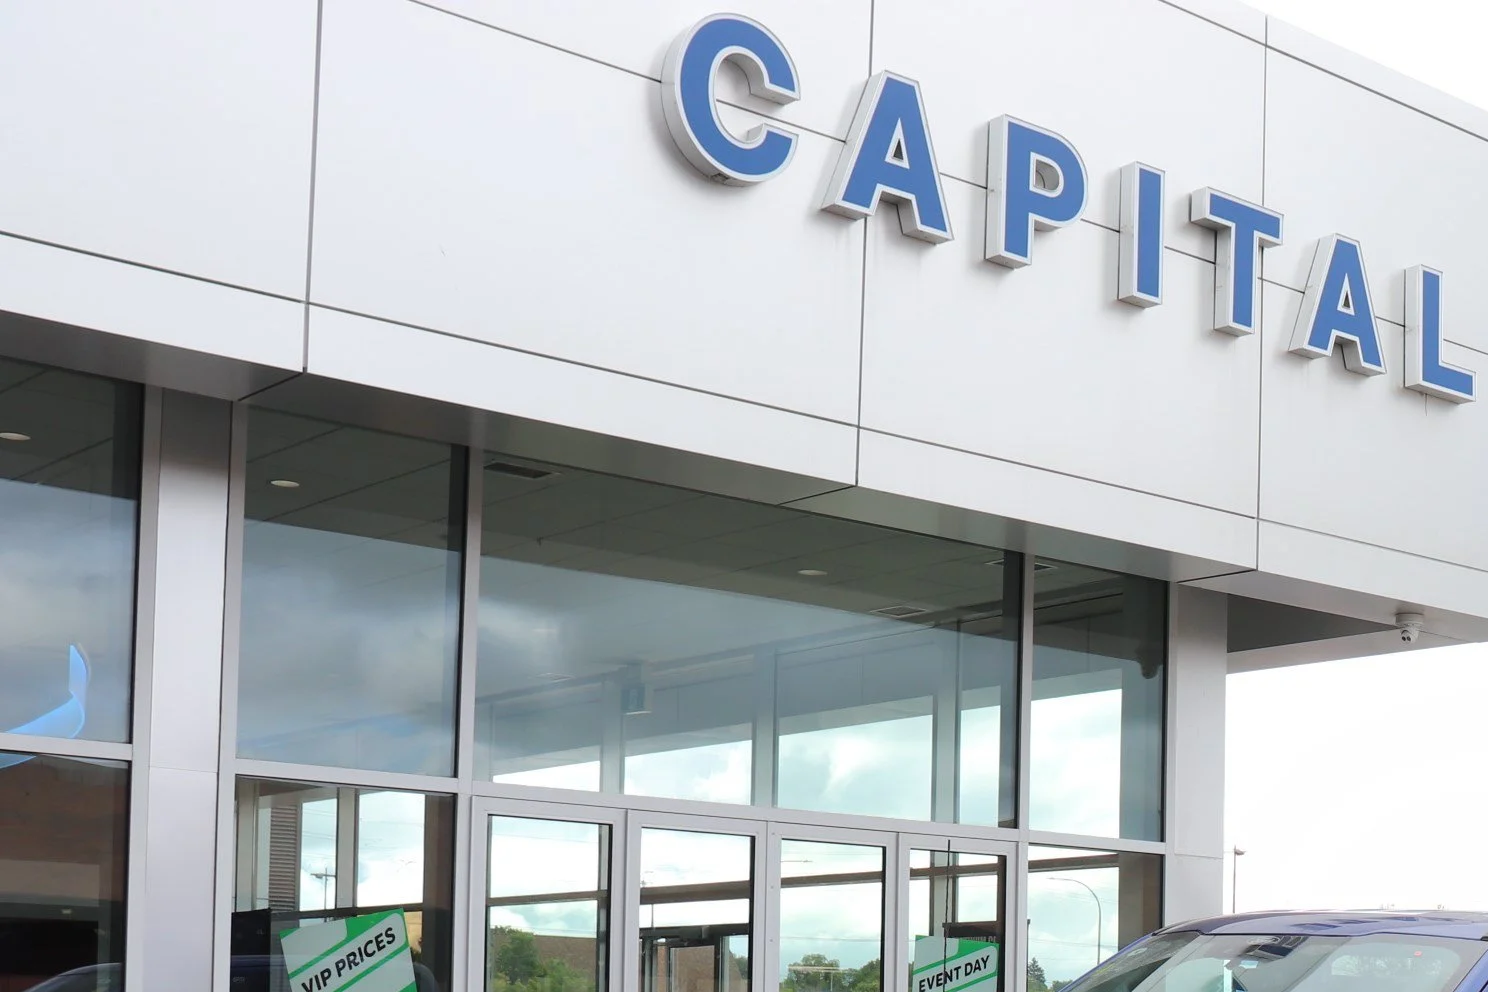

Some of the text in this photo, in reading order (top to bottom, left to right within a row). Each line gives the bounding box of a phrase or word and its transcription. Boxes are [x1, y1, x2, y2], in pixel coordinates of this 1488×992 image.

[661, 12, 1477, 404] CAPITAL
[334, 926, 397, 978] PRICES
[964, 954, 991, 977] DAY
